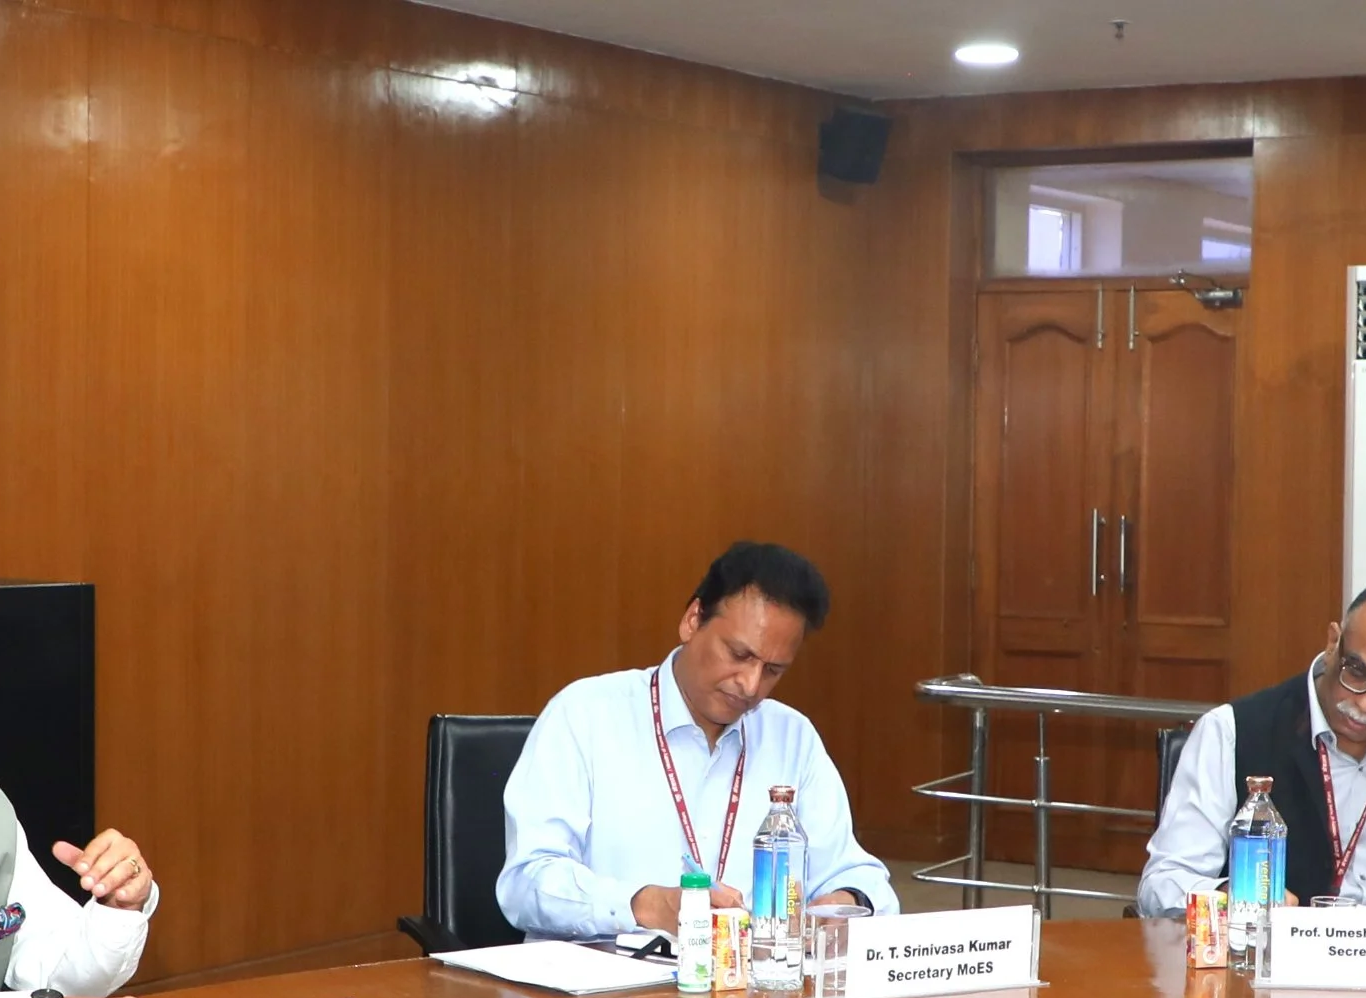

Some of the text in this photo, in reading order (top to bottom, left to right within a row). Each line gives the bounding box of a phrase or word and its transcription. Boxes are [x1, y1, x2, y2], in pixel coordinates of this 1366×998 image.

[1290, 927, 1321, 937] Prof.
[866, 939, 1012, 962] Dr. T. Srinivasa Kumar
[888, 961, 994, 982] Secretary MoES
